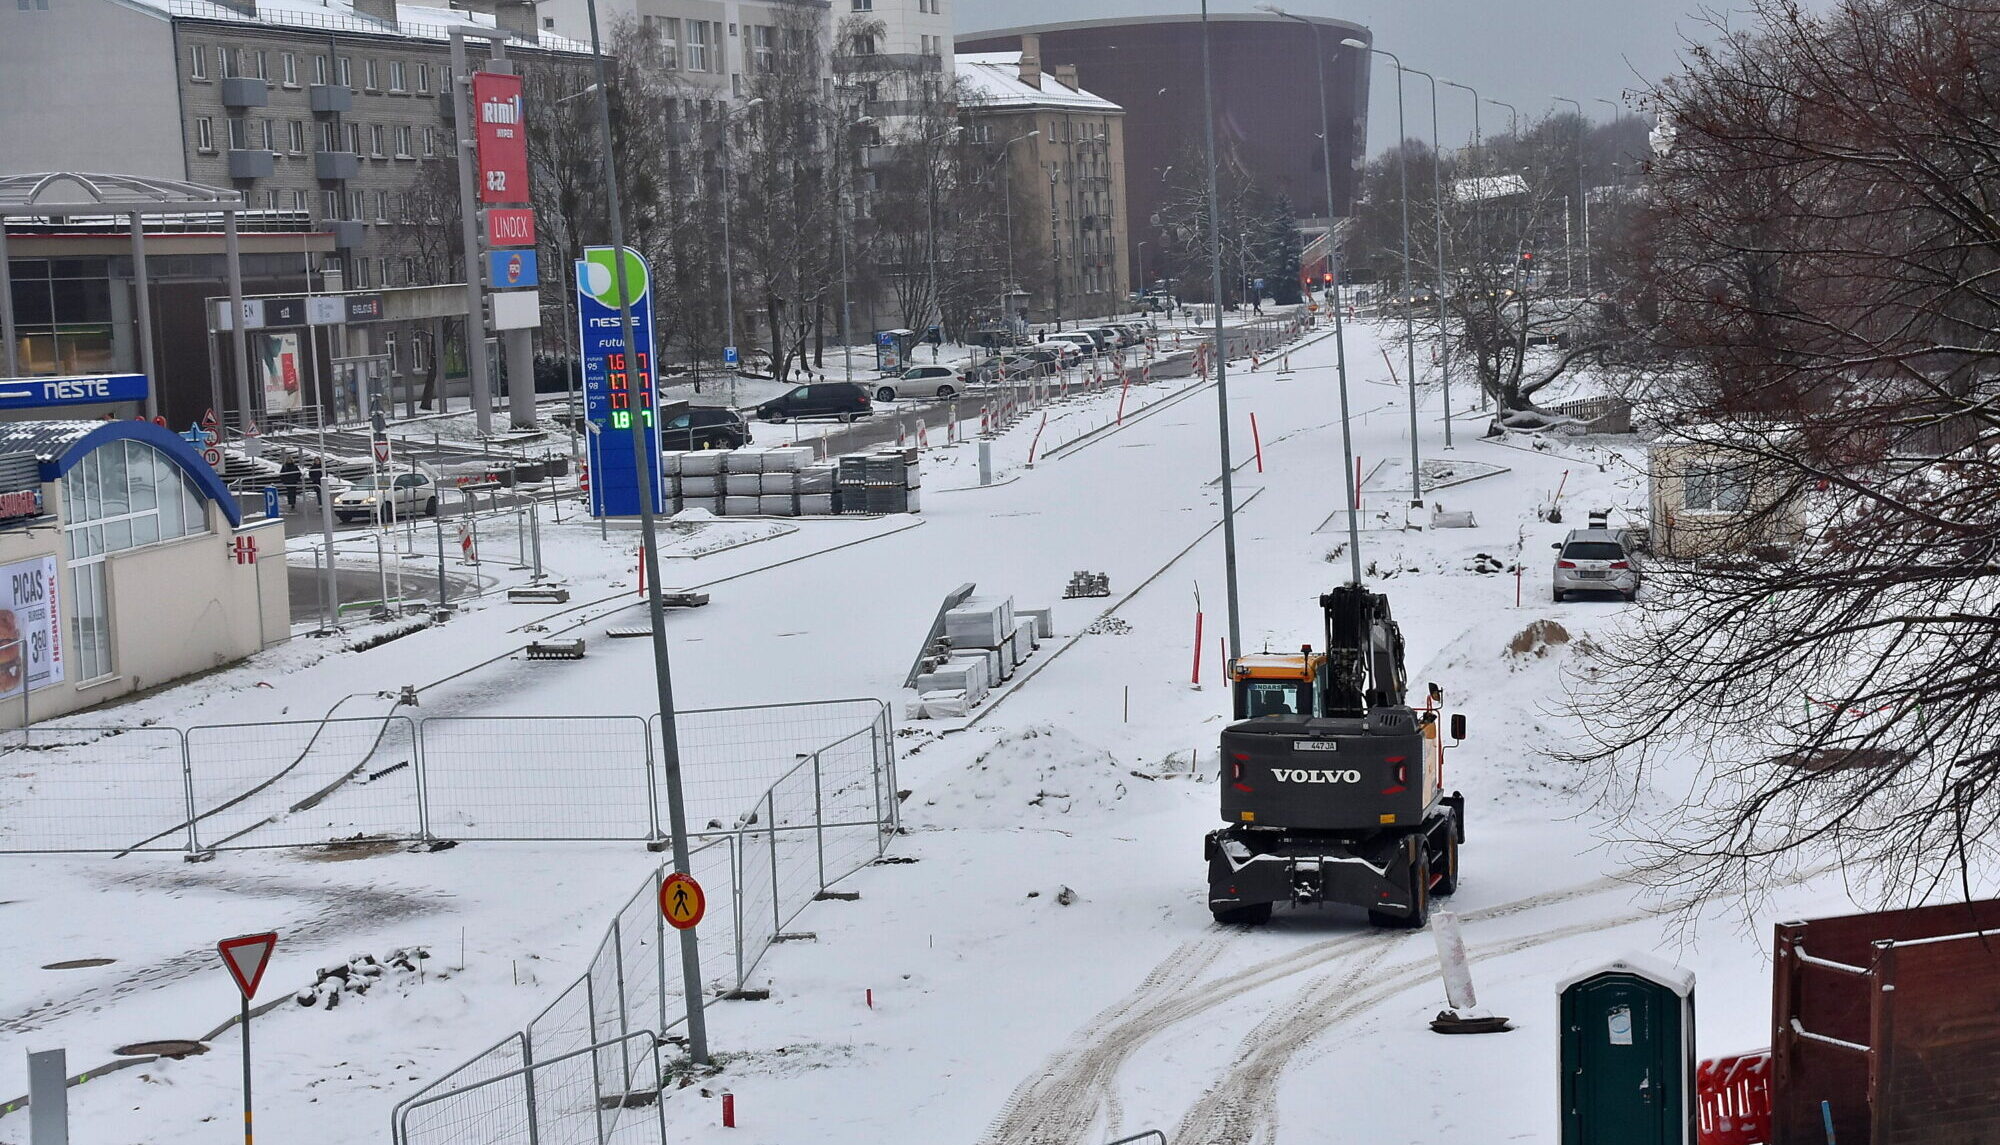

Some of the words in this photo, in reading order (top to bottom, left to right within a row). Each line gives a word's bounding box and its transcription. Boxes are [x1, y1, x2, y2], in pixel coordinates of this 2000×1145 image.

[487, 171, 505, 191] 8-22
[590, 316, 640, 328] NESE
[587, 363, 598, 371] 95
[609, 353, 647, 370] 1.67
[44, 379, 110, 399] NESTE
[610, 373, 649, 390] 1.77
[590, 401, 597, 409] D
[611, 392, 649, 409] 1.77
[612, 411, 652, 429] 1.87
[12, 570, 43, 606] PICAS
[48, 575, 60, 662] HESBURGER
[1271, 768, 1361, 783] VOLVO
